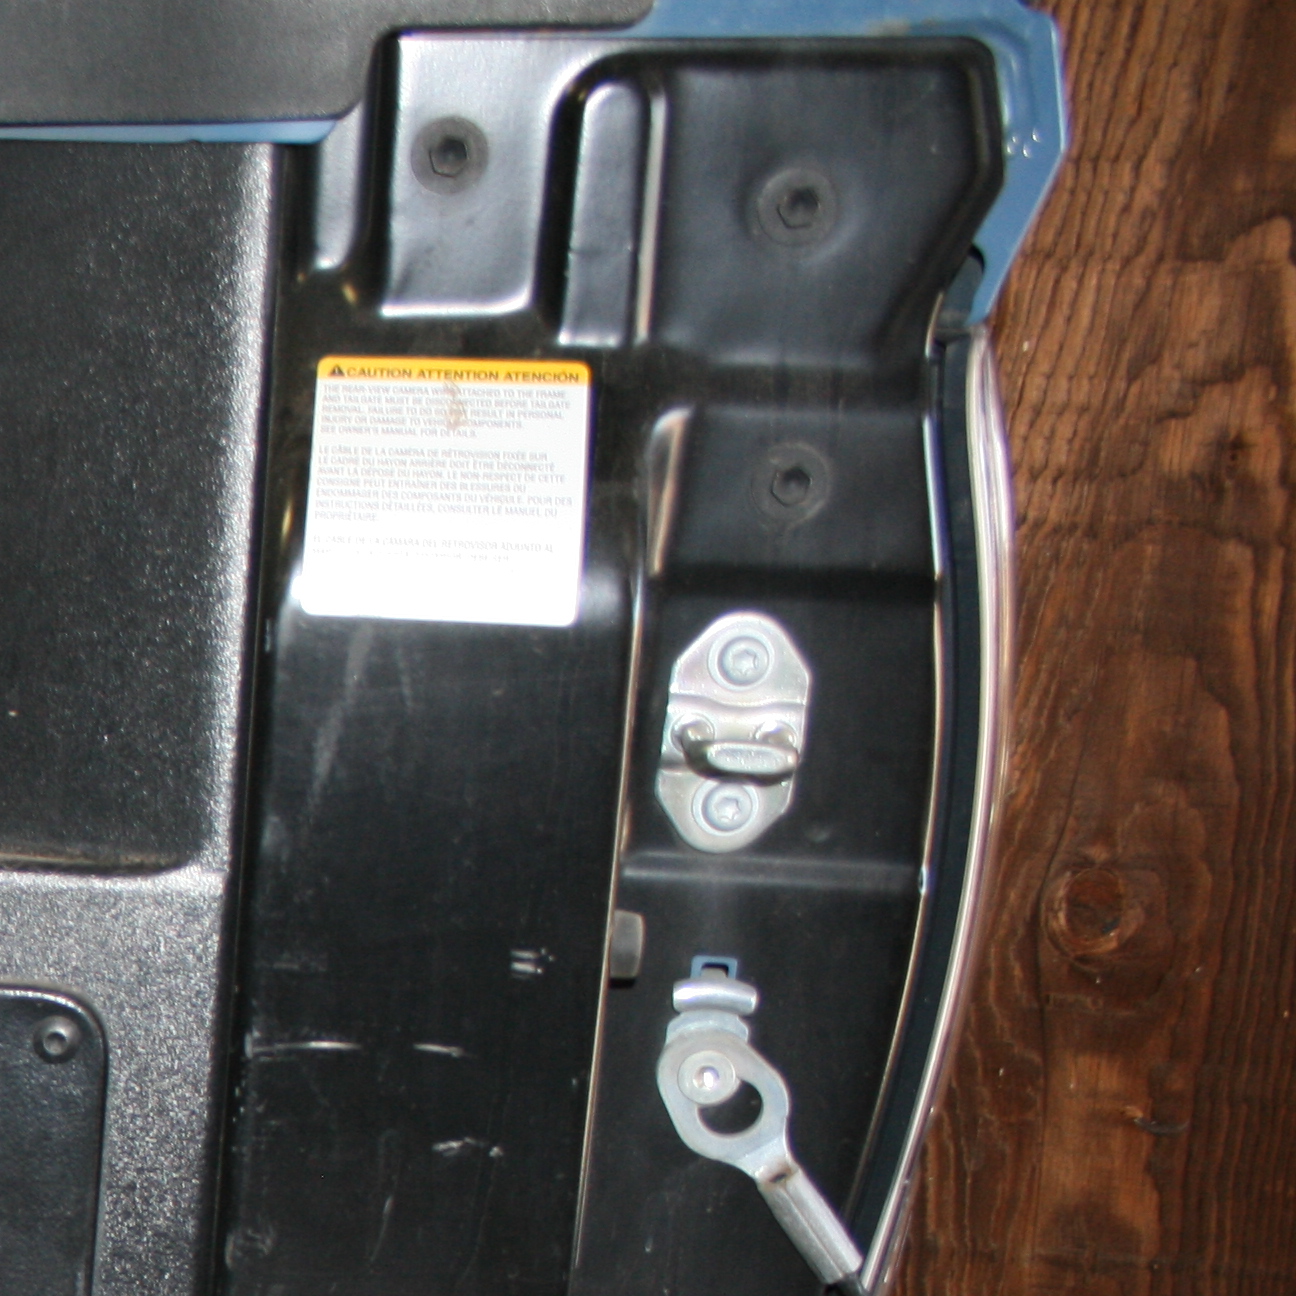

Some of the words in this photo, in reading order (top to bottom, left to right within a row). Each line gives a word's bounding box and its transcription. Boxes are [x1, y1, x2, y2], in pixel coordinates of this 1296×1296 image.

[346, 366, 411, 379] CAUTION
[416, 368, 498, 381] ATTENTION
[502, 368, 579, 383] ATENCIÓN
